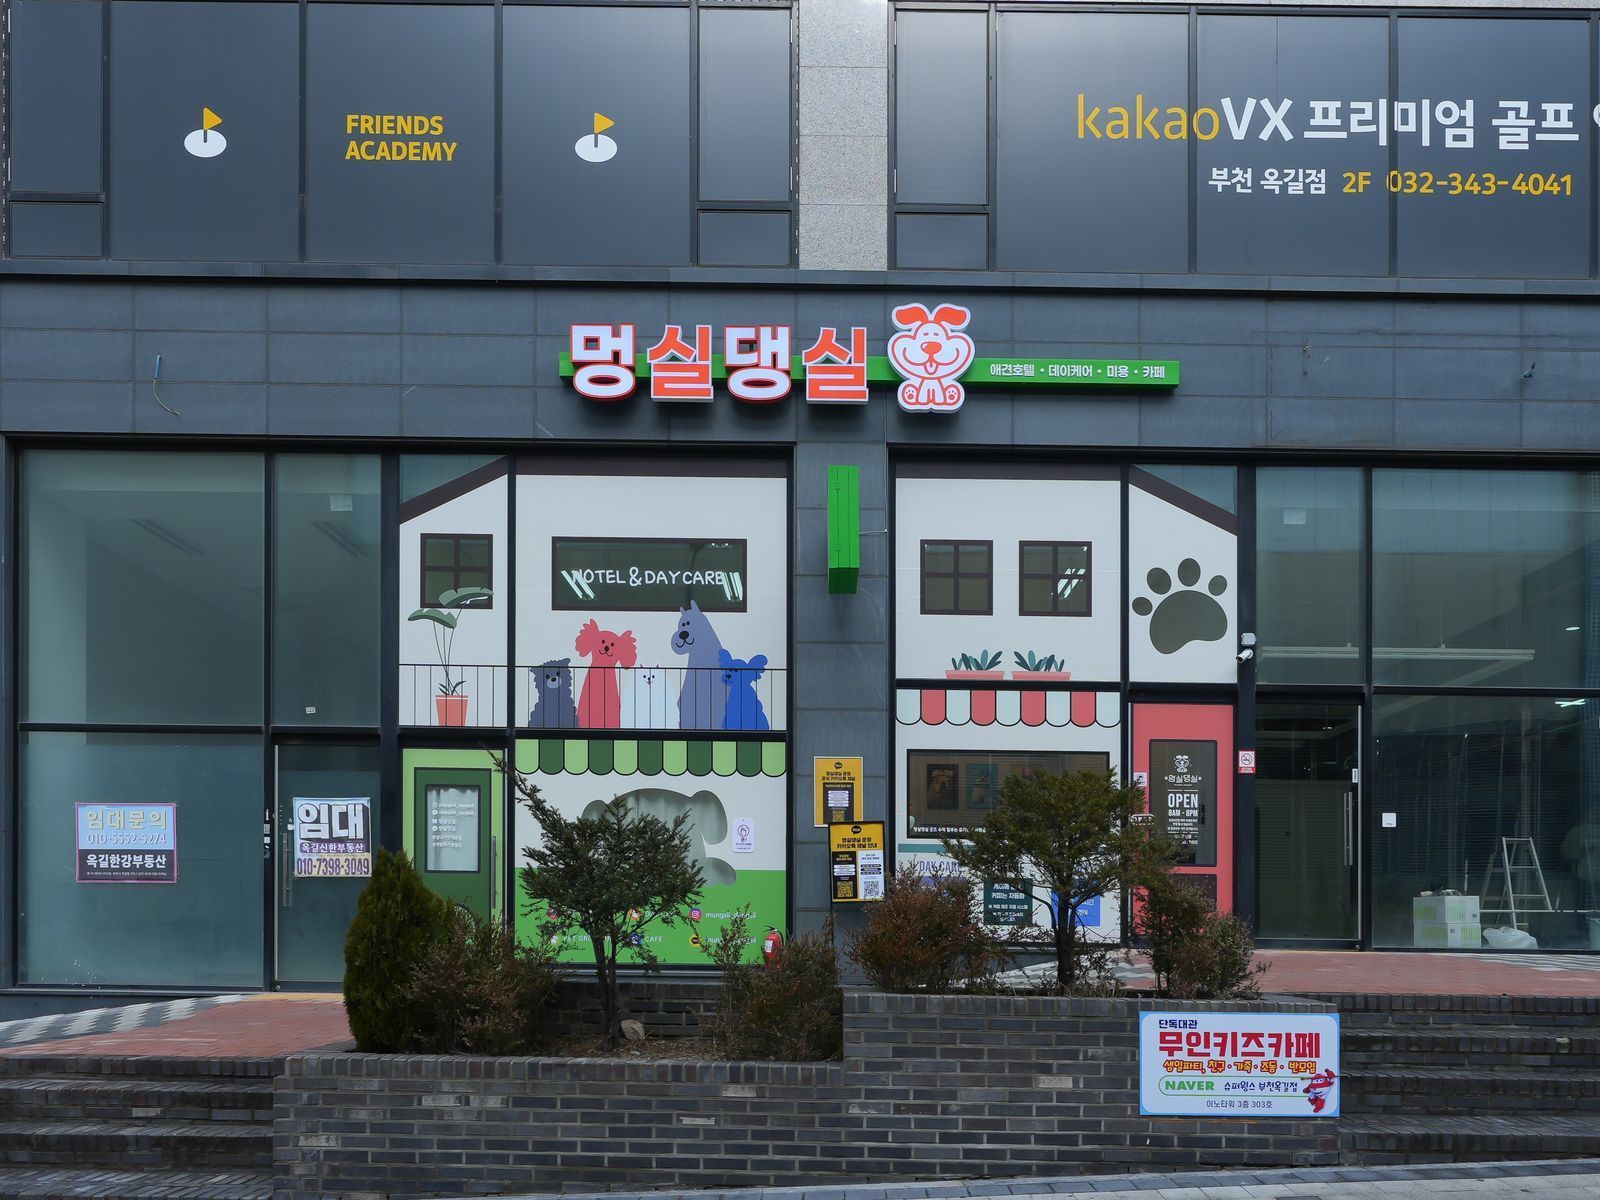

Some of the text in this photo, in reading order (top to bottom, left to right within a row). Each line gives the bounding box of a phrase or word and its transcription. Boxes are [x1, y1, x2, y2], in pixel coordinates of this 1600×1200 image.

[346, 114, 444, 136] FRIENDS
[1303, 98, 1474, 149] 프리미엄
[1491, 100, 1580, 150] 골프
[345, 140, 458, 161] ACADEMY
[1208, 167, 1573, 196] 부천 옥길점 2F 032-343-4041
[570, 323, 869, 404] 멍실댕실
[990, 363, 1165, 379] 애견호텔 데이케어 미용 카페
[1167, 793, 1198, 808] OPEN
[88, 810, 167, 830] 임대문의
[1168, 809, 1180, 817] 8AM
[1185, 809, 1198, 817] 8PM
[298, 803, 364, 840] 임대
[301, 843, 364, 853] 옥길신한부동산
[86, 854, 167, 869] 옥길한강부동산
[297, 858, 369, 876] 010-7398-3049
[644, 935, 663, 943] CAFE
[1158, 1019, 1198, 1029] 단독대관
[1159, 1031, 1320, 1058] 무인키즈카페
[1163, 1060, 1317, 1074] 생일파티, 친구 가족 조동 반모임
[1165, 1081, 1298, 1092] NAVER 슈퍼윙스 부천옥길점
[1206, 1100, 1273, 1109] 이노타워 3층 303호
